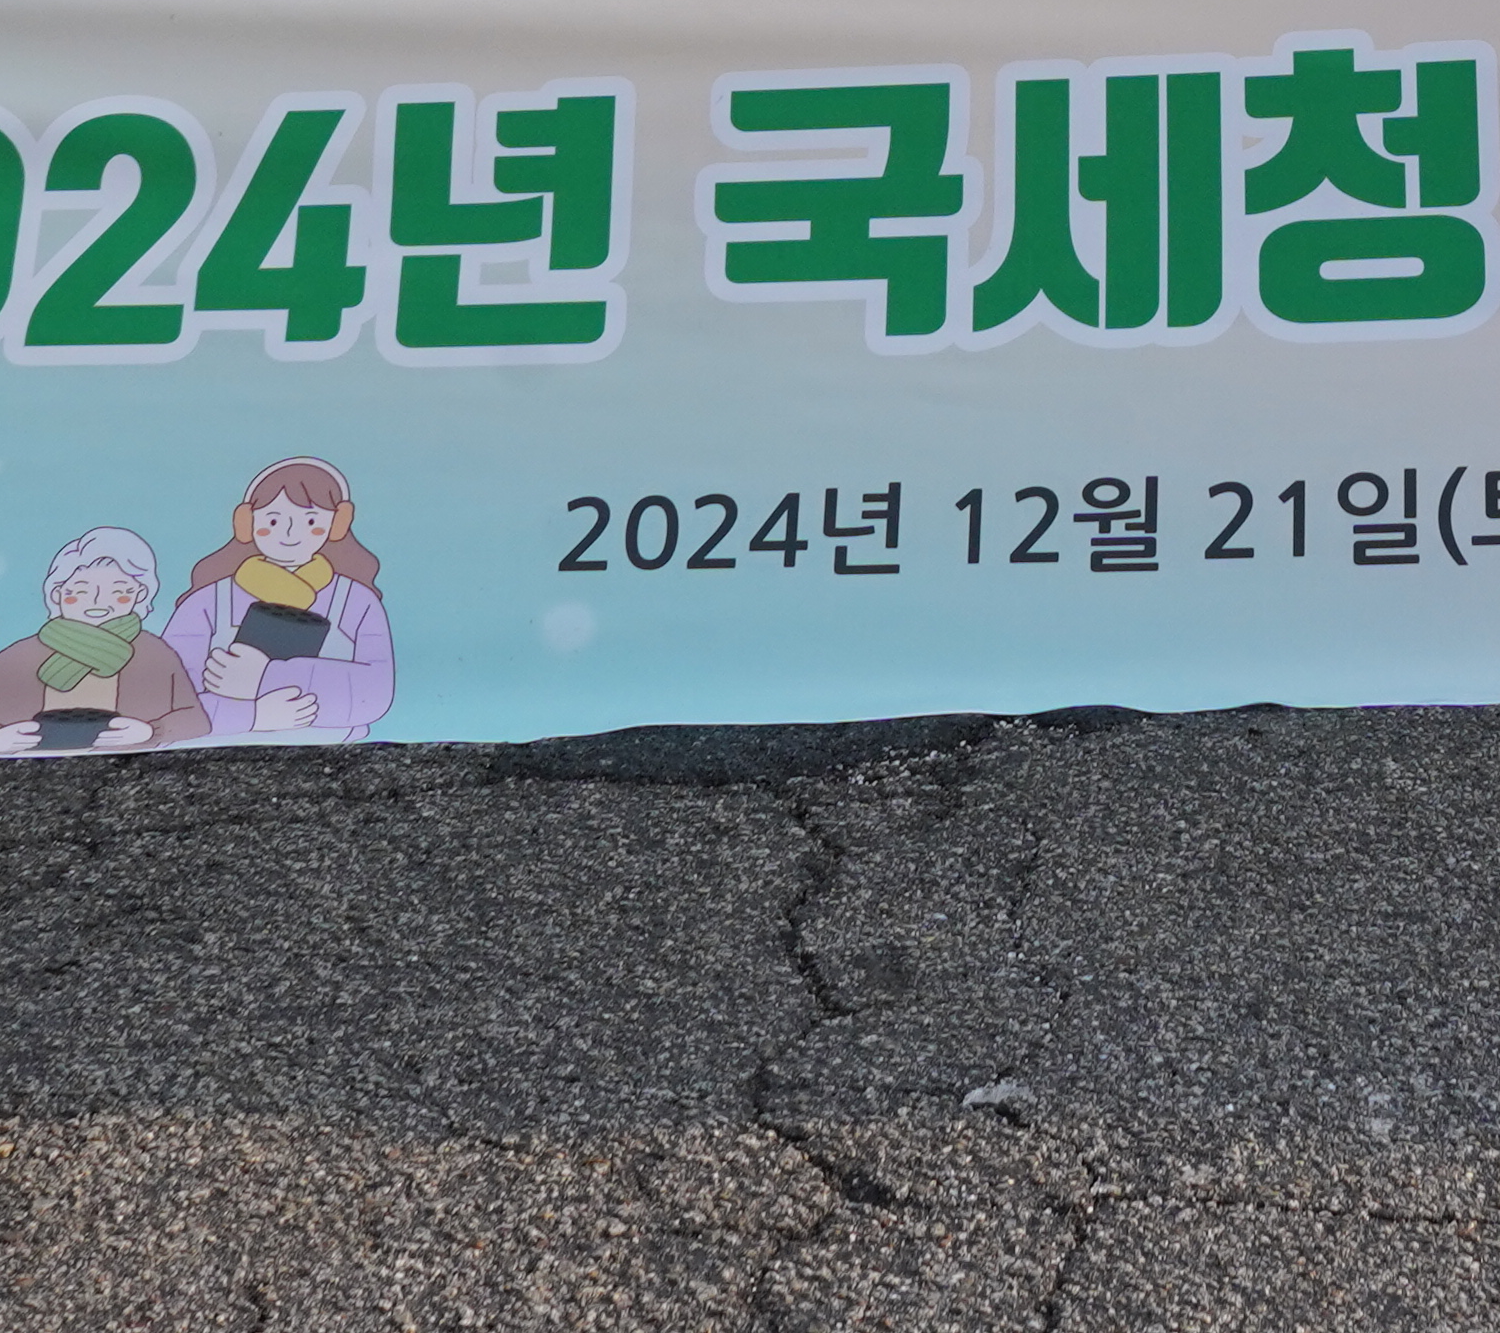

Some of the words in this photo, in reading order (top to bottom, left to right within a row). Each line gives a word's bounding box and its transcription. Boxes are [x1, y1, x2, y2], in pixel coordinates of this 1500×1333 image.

[716, 50, 1484, 334] 국세청
[559, 482, 901, 574] 2024년
[956, 476, 1158, 572] 12월
